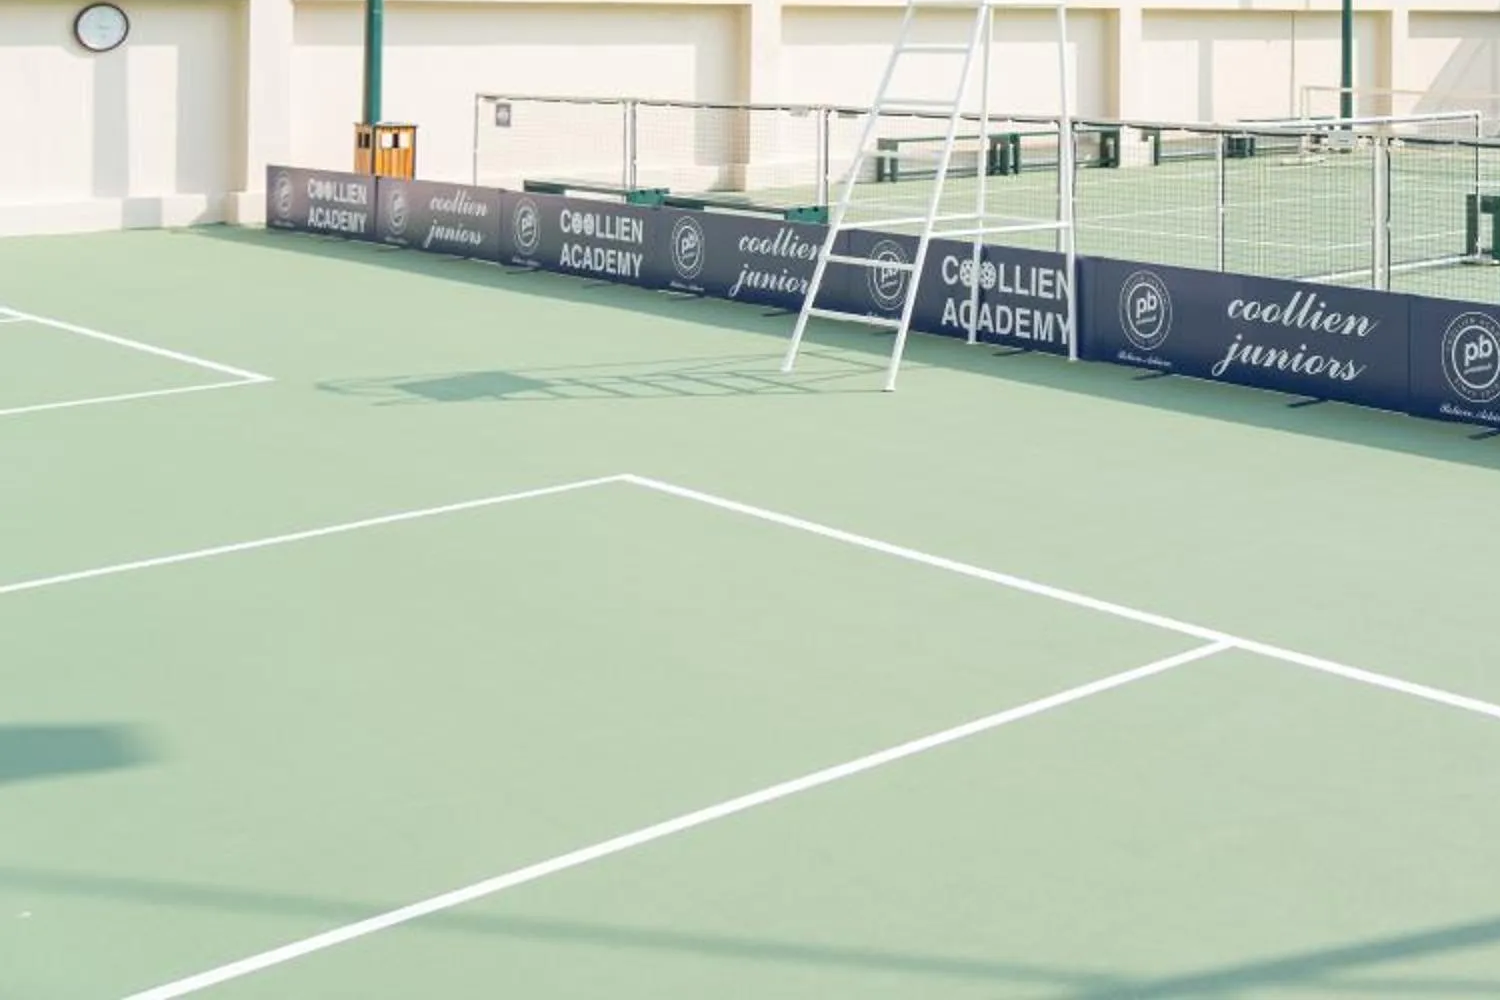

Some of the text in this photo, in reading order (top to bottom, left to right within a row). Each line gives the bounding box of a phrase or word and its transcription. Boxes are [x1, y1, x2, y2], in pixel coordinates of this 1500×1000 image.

[560, 208, 644, 244] COOLLIEN
[560, 242, 643, 278] ACADEMY
[728, 263, 809, 298] junior
[1135, 290, 1158, 319] pb
[1227, 290, 1380, 338] coollien
[1211, 333, 1369, 382] juniors
[1464, 334, 1493, 367] pb
